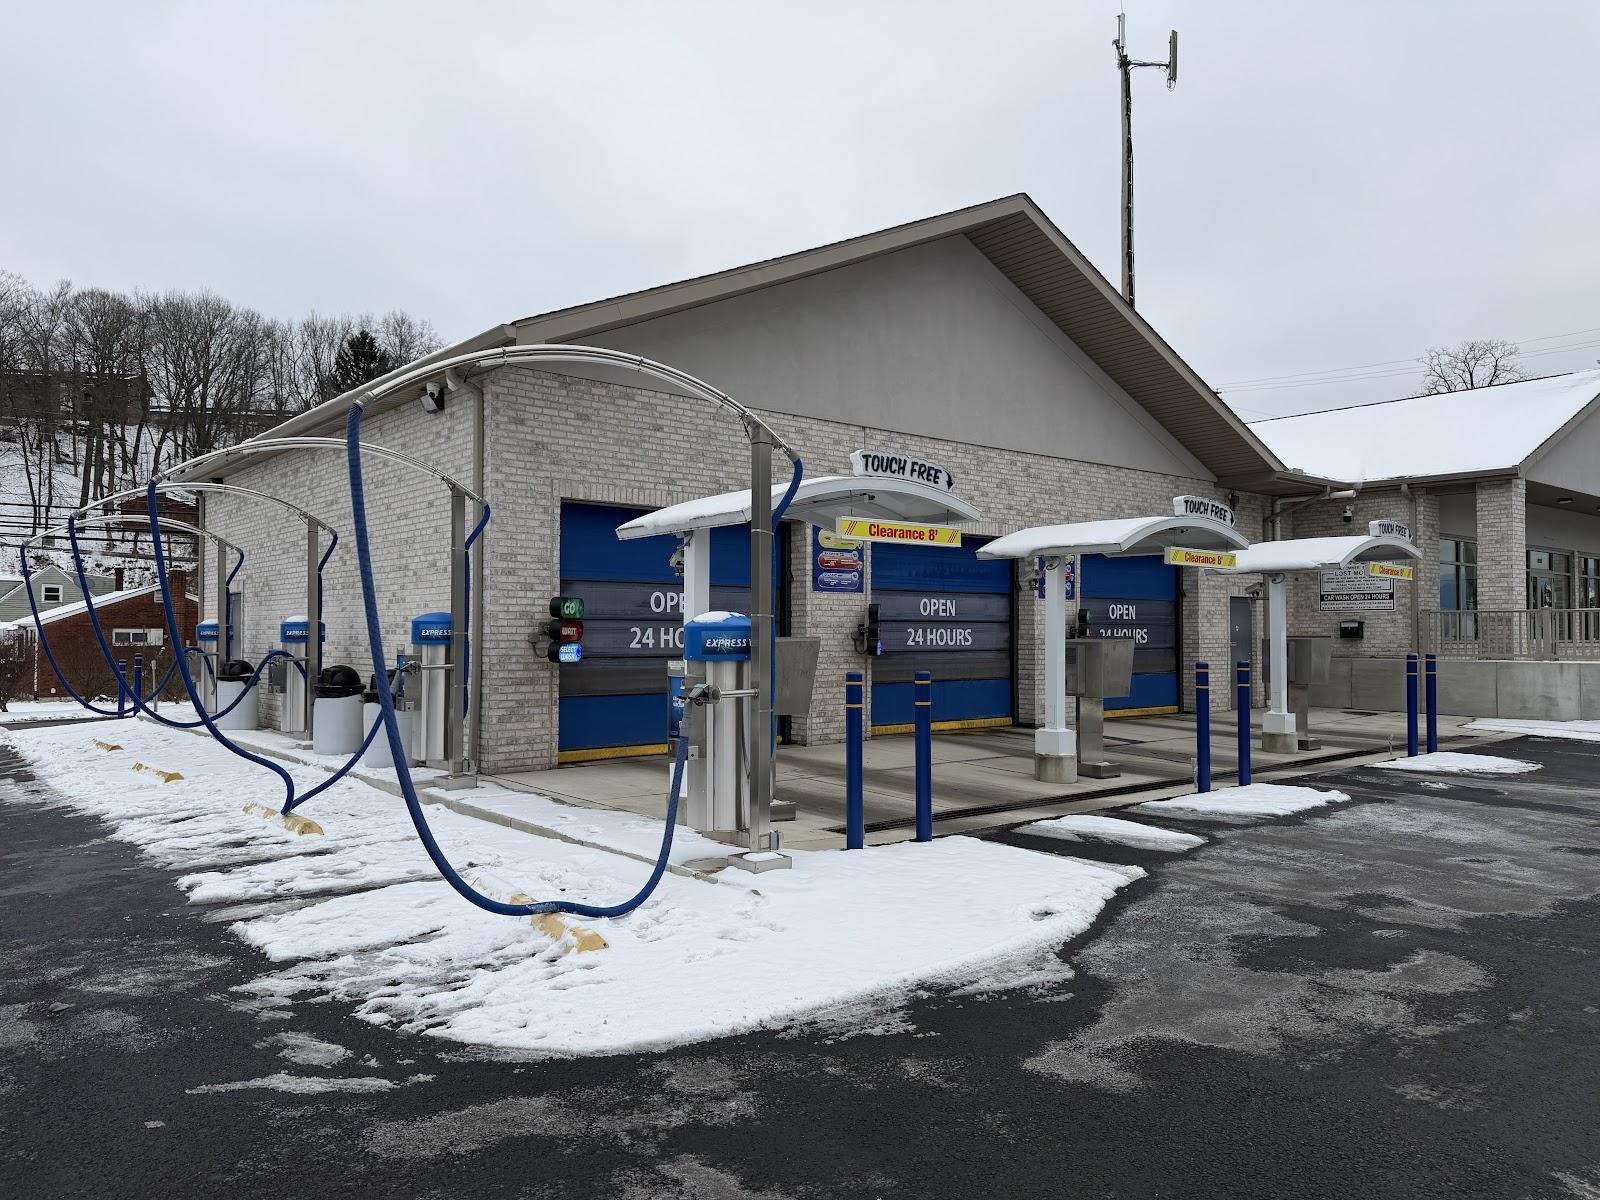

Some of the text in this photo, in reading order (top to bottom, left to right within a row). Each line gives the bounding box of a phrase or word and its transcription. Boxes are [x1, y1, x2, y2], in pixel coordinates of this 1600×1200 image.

[862, 454, 942, 485] TOUCH FREE
[1184, 499, 1228, 521] TOUCH FREE
[868, 523, 925, 540] Clearance
[1378, 523, 1395, 535] TOUCH
[1184, 552, 1216, 565] Clearance
[1379, 565, 1400, 577] Clearance
[650, 591, 685, 613] OPE
[1350, 593, 1364, 601] OPEN
[564, 602, 576, 615] GO
[920, 598, 956, 617] OPEN
[1109, 604, 1136, 620] OPEN
[629, 627, 655, 649] 24
[706, 638, 747, 648] EXPRESS
[906, 628, 972, 646] 24 HOURS
[560, 645, 577, 653] SELECT
